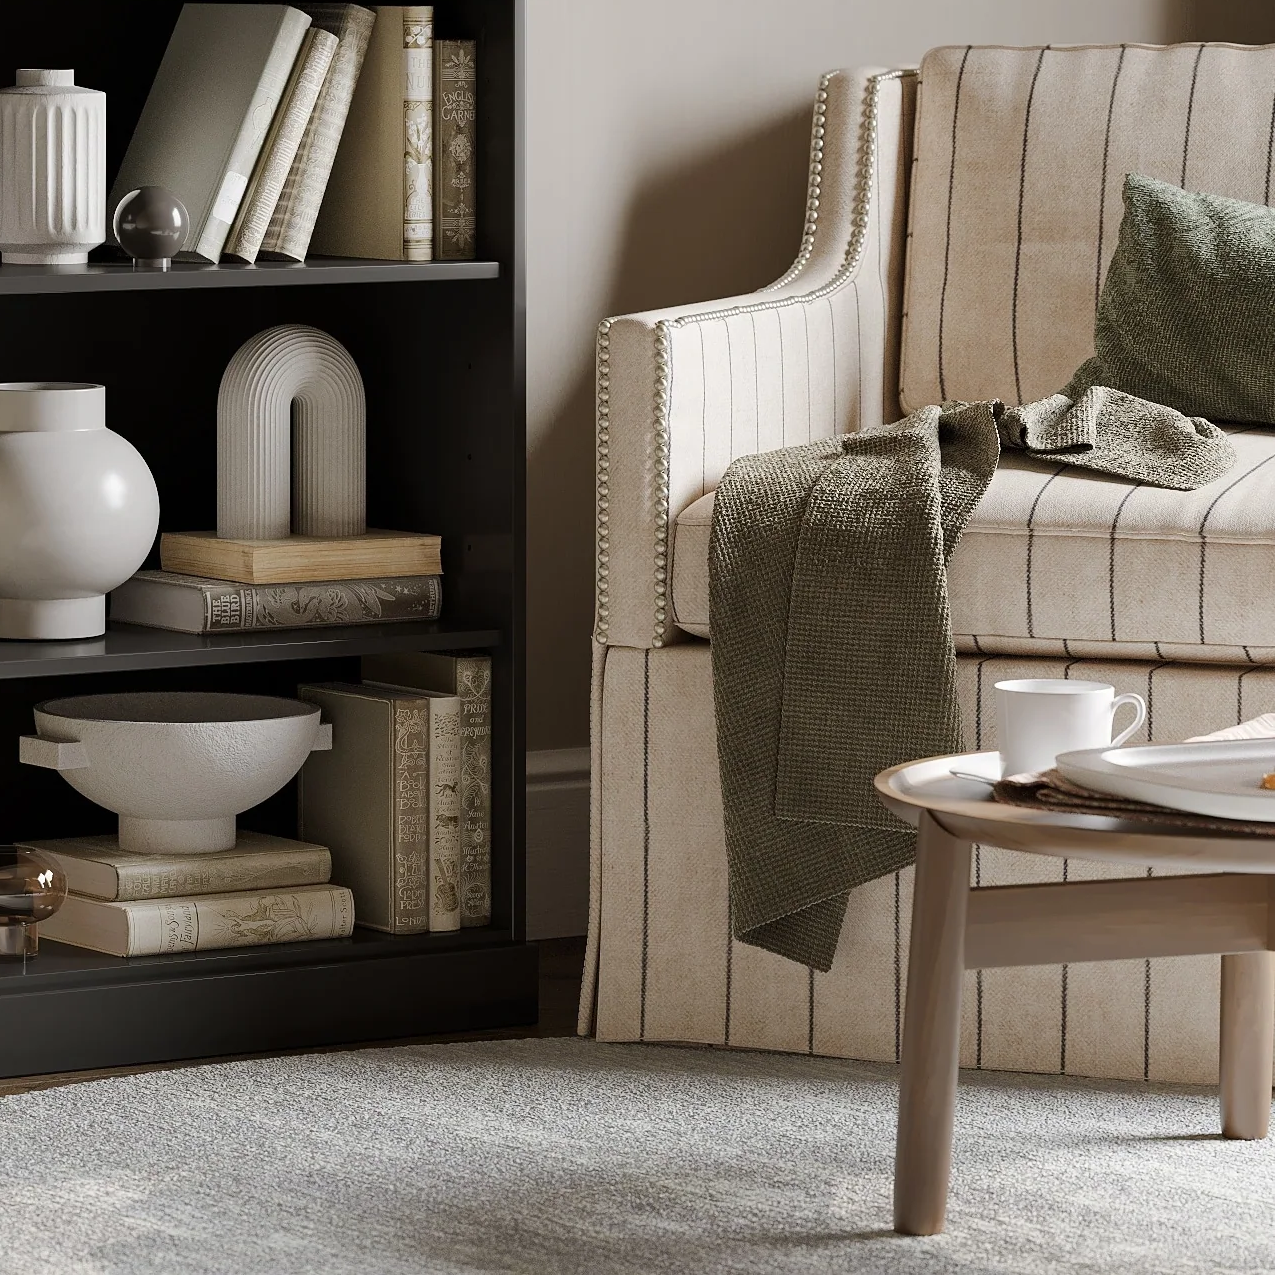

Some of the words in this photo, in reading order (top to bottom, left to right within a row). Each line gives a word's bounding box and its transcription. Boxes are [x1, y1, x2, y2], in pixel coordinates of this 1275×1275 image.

[411, 56, 432, 69] THE
[441, 105, 476, 122] GARNE
[212, 600, 222, 623] THE
[220, 594, 231, 625] BLUE
[230, 594, 240, 625] BIRD
[338, 891, 348, 913] Scott
[179, 905, 194, 945] Fairyland
